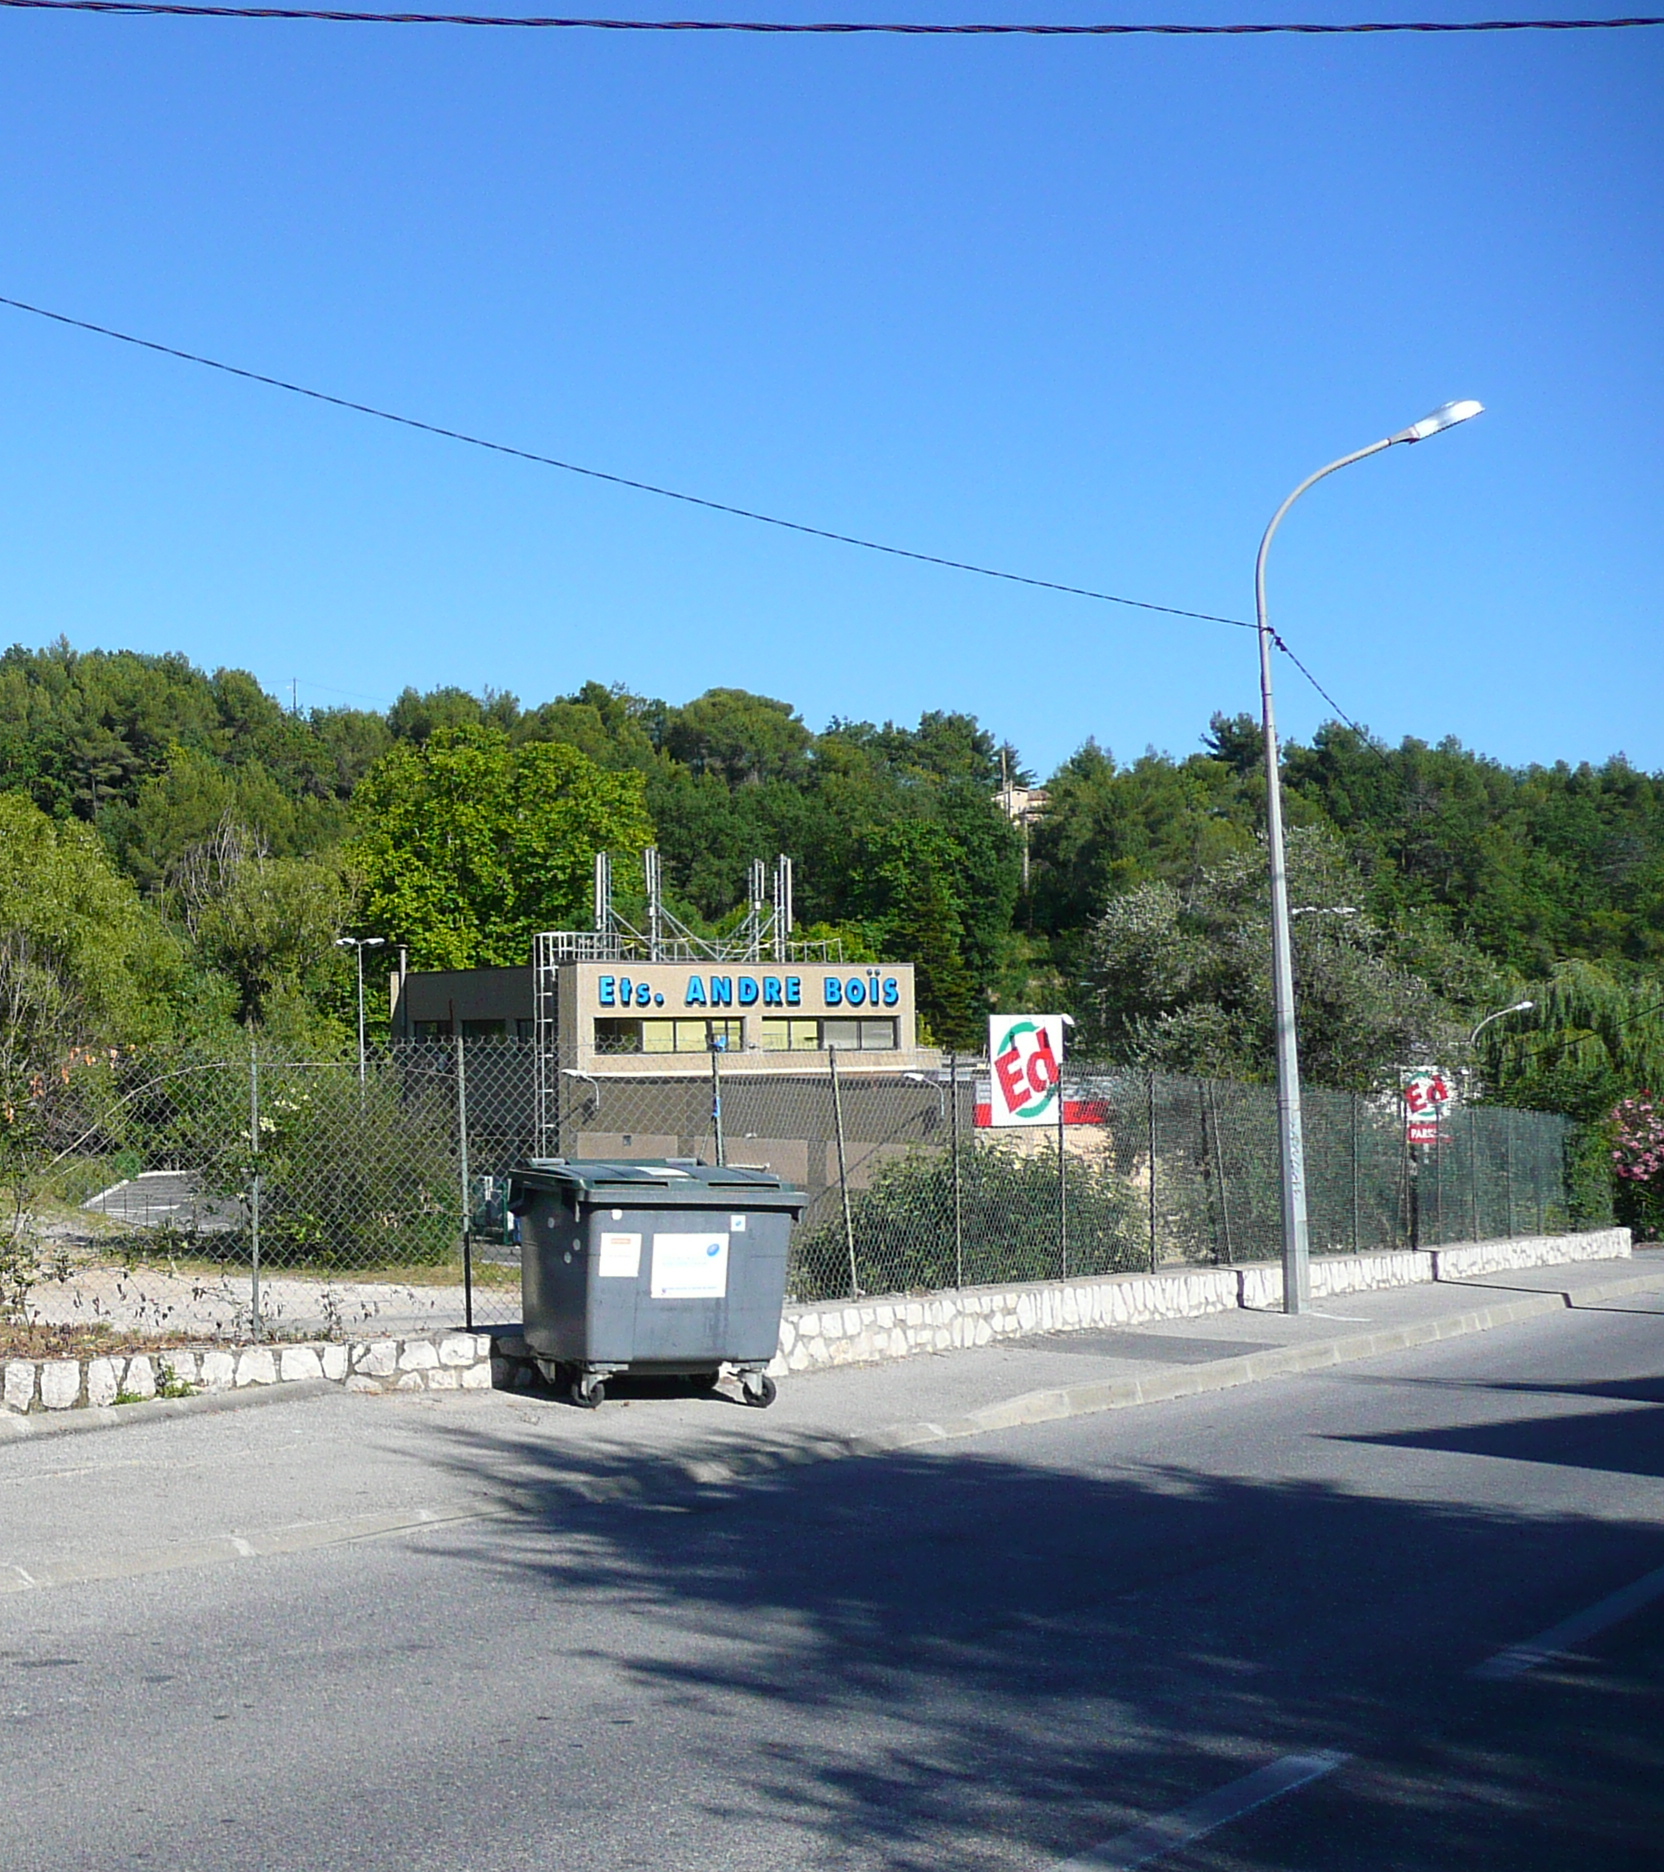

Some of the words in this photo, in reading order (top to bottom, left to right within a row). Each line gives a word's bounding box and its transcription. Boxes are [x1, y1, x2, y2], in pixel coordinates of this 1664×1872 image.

[598, 975, 664, 1005] Ets.
[685, 975, 802, 1006] ANDRE
[994, 1027, 1061, 1114] Ed
[1404, 1074, 1449, 1113] Ed
